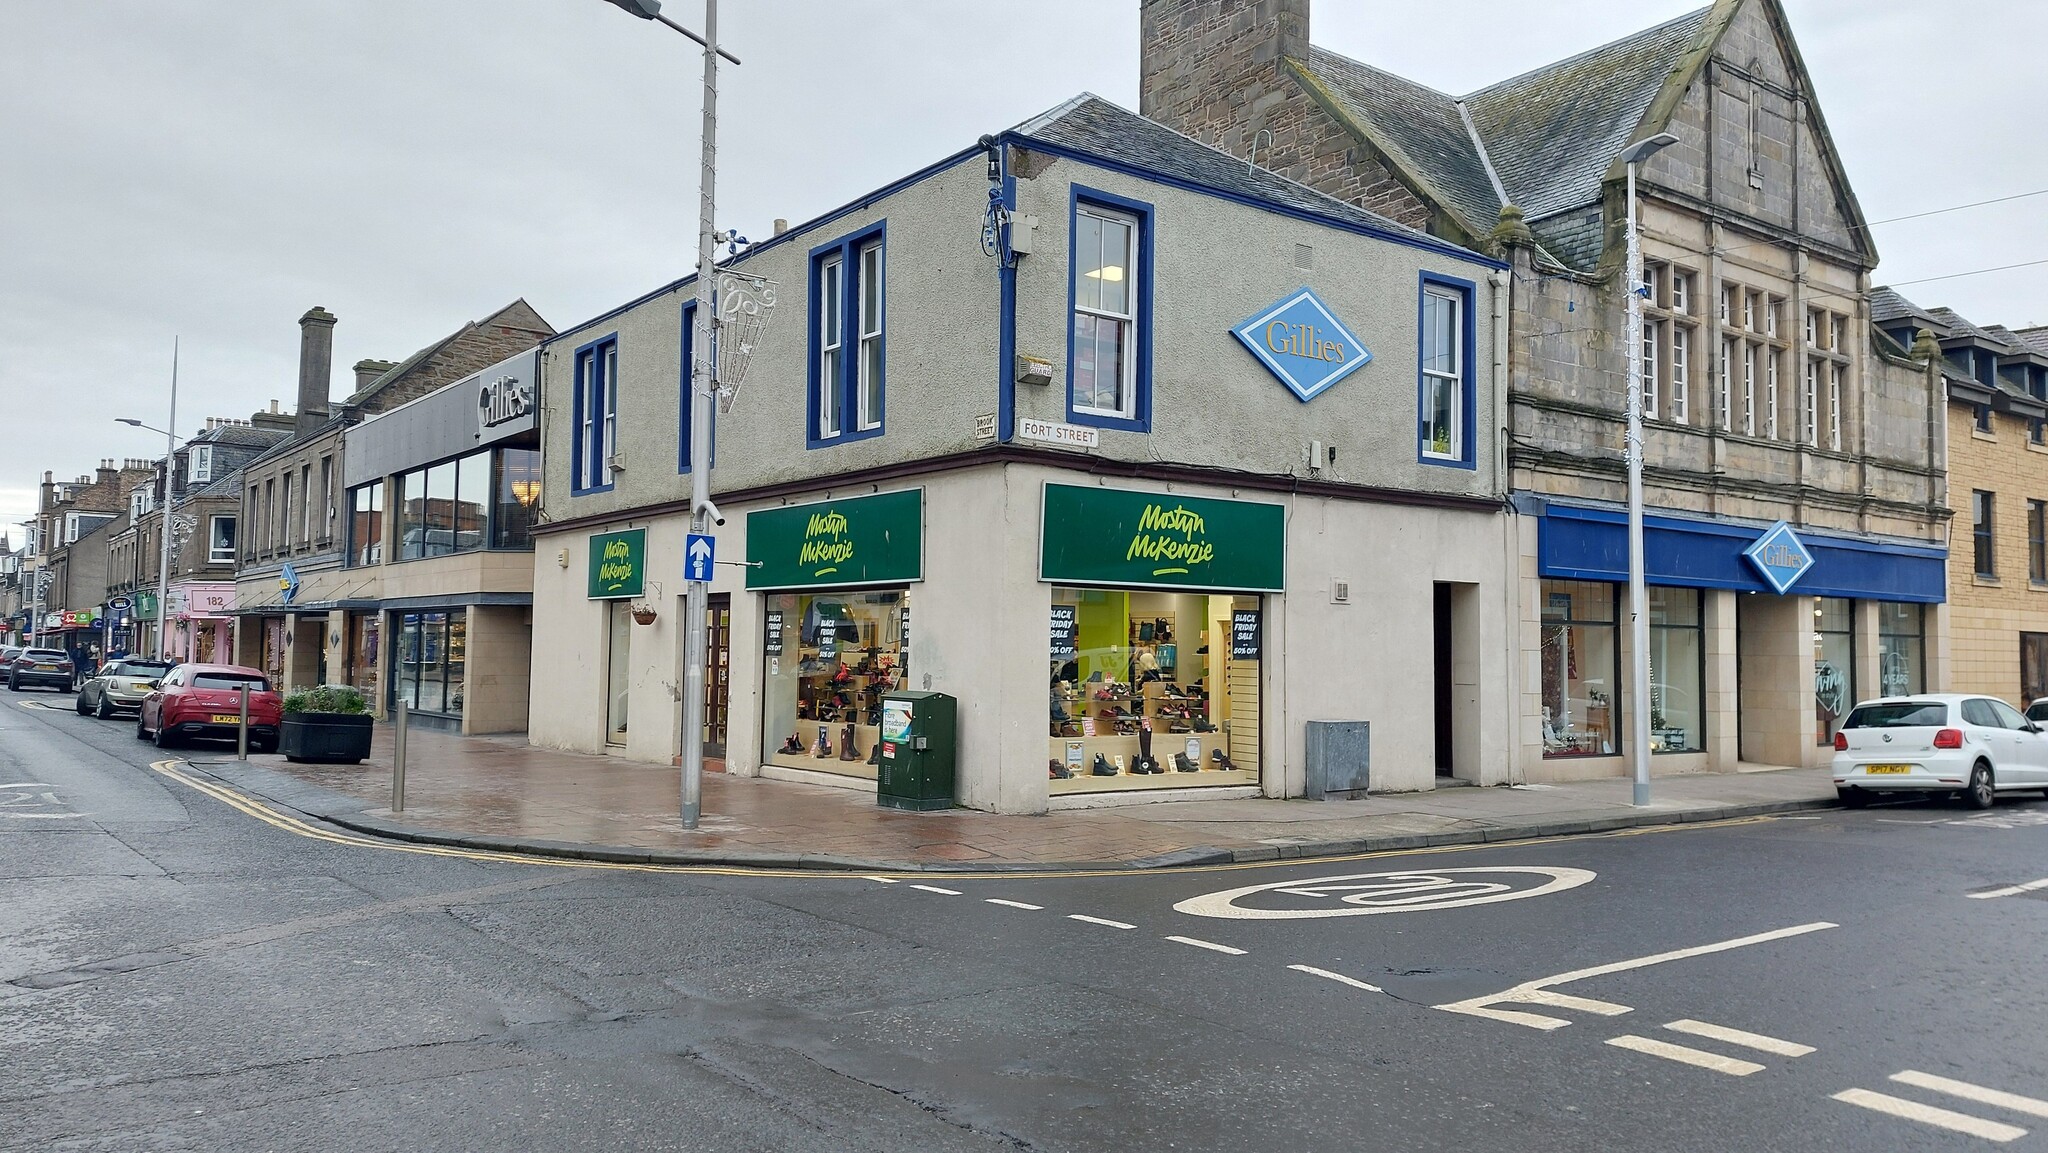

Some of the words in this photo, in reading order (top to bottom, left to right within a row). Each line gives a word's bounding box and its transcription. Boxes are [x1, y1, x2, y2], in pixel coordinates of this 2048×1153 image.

[1266, 321, 1345, 364] Gillies
[478, 375, 531, 427] Gillies
[976, 418, 994, 428] BROOK
[976, 427, 994, 436] STREET
[1025, 423, 1052, 437] FORT
[1056, 429, 1094, 443] STREET
[806, 510, 848, 542] Mostyn
[1138, 504, 1205, 542] Mostyn
[604, 539, 629, 564] Mostyn
[799, 540, 854, 567] McKenzie
[1126, 535, 1214, 565] McKenzie
[1763, 544, 1803, 569] Gillies
[598, 562, 632, 583] McKenzie
[207, 597, 224, 606] 182
[1234, 623, 1257, 632] FRIDAY
[1235, 614, 1256, 623] BLACK
[1631, 612, 1637, 622] 7
[1237, 632, 1254, 641] SALE
